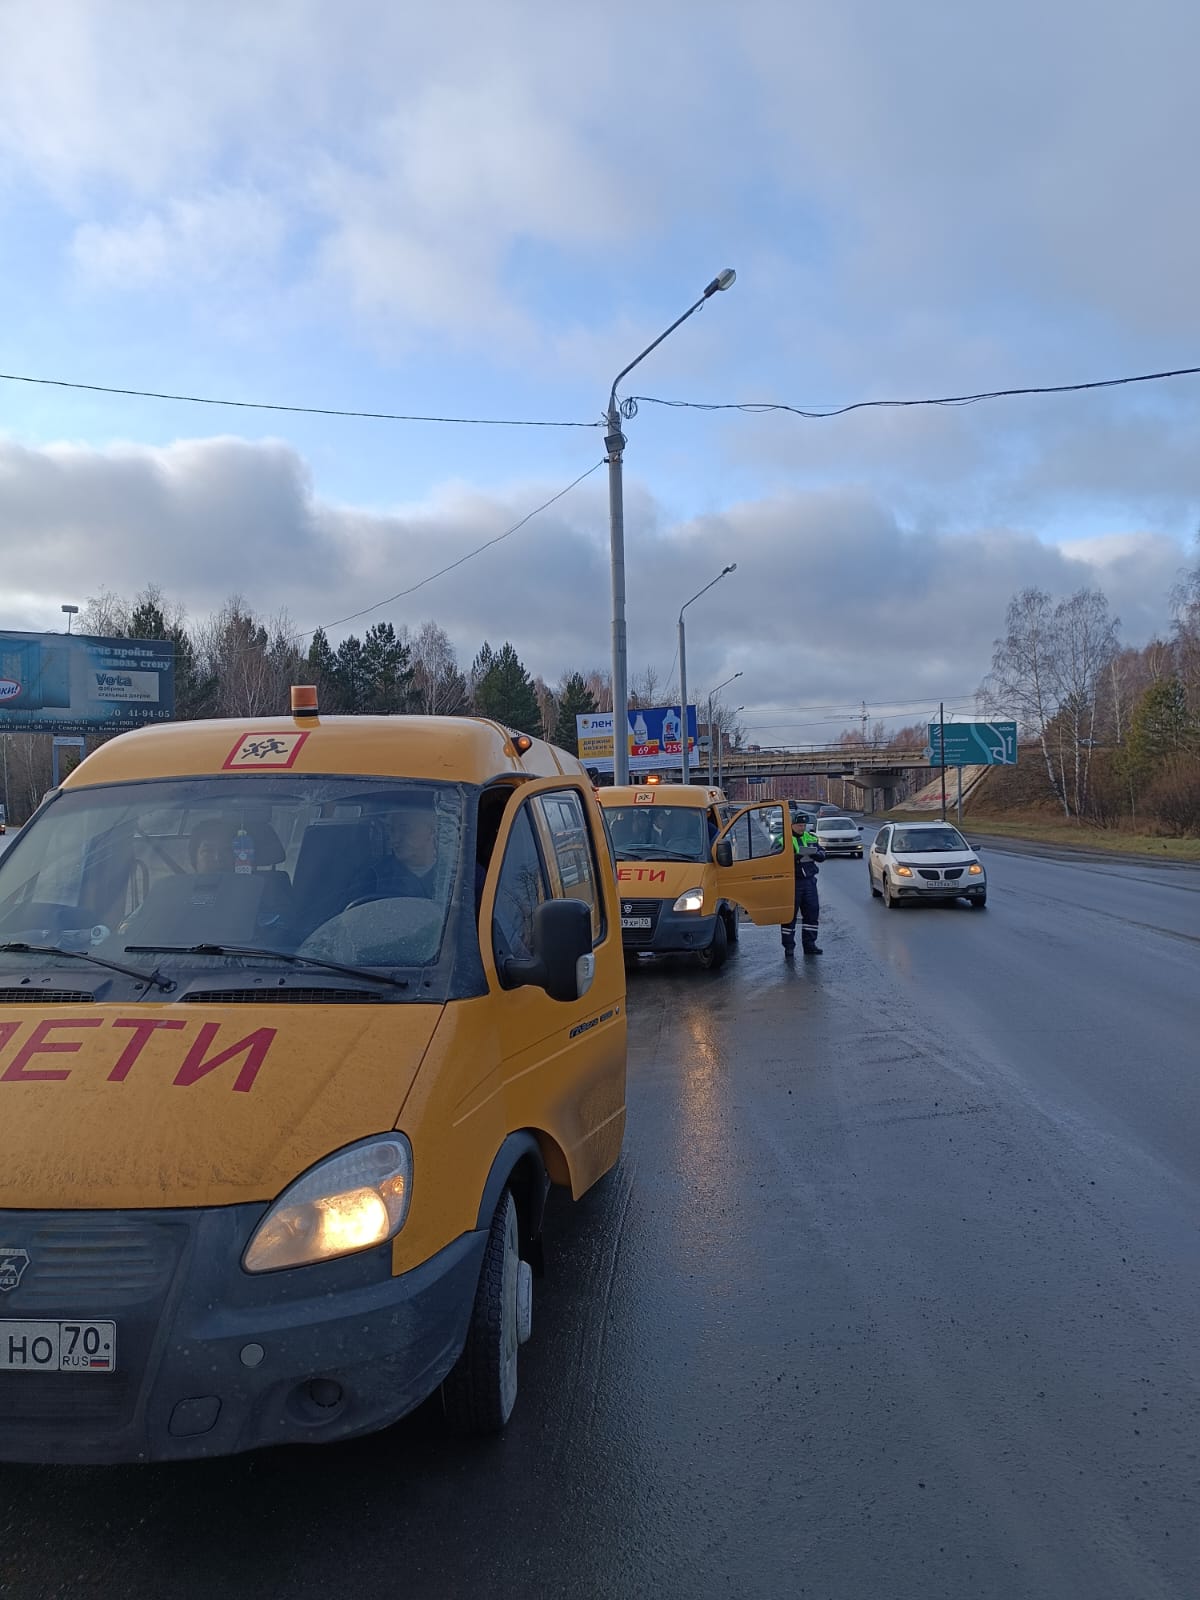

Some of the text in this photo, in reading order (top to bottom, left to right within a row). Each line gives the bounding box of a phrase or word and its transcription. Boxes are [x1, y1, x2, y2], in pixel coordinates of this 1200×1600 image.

[114, 647, 154, 658] пройти
[140, 660, 171, 671] стену
[638, 746, 649, 755] 69
[617, 868, 667, 883] ЕТИ
[0, 1017, 278, 1093] ЕТИ
[65, 1326, 100, 1355] 70
[62, 1355, 89, 1366] RUS
